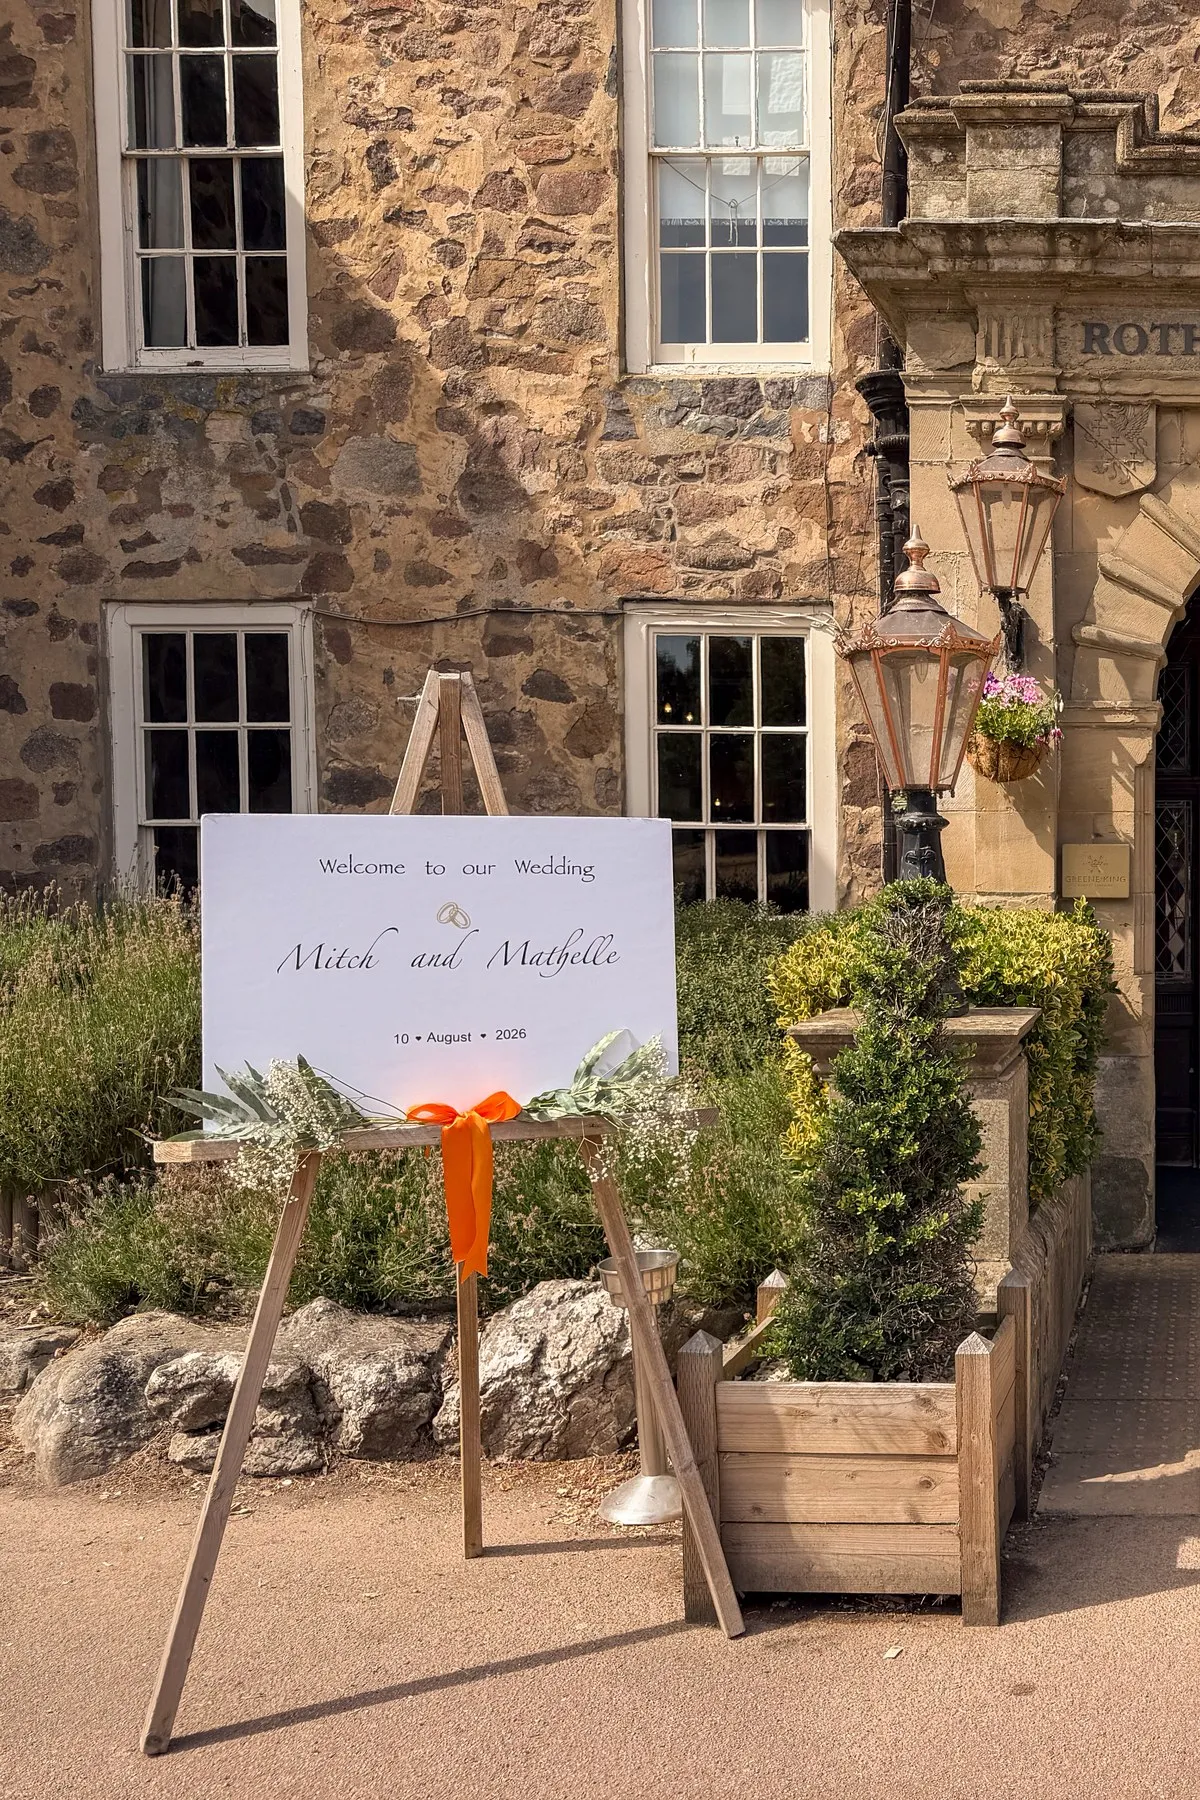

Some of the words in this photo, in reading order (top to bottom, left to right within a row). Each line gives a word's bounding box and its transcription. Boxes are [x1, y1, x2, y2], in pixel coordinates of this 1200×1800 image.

[319, 853, 406, 875] Welcome
[425, 861, 446, 876] to
[462, 864, 496, 875] our
[514, 855, 596, 883] Wedding
[276, 926, 399, 975] Mitch
[410, 928, 480, 970] and
[486, 927, 622, 979] Mathelle
[393, 1033, 410, 1045] 10
[426, 1031, 472, 1045] August
[495, 1028, 527, 1041] 2026
